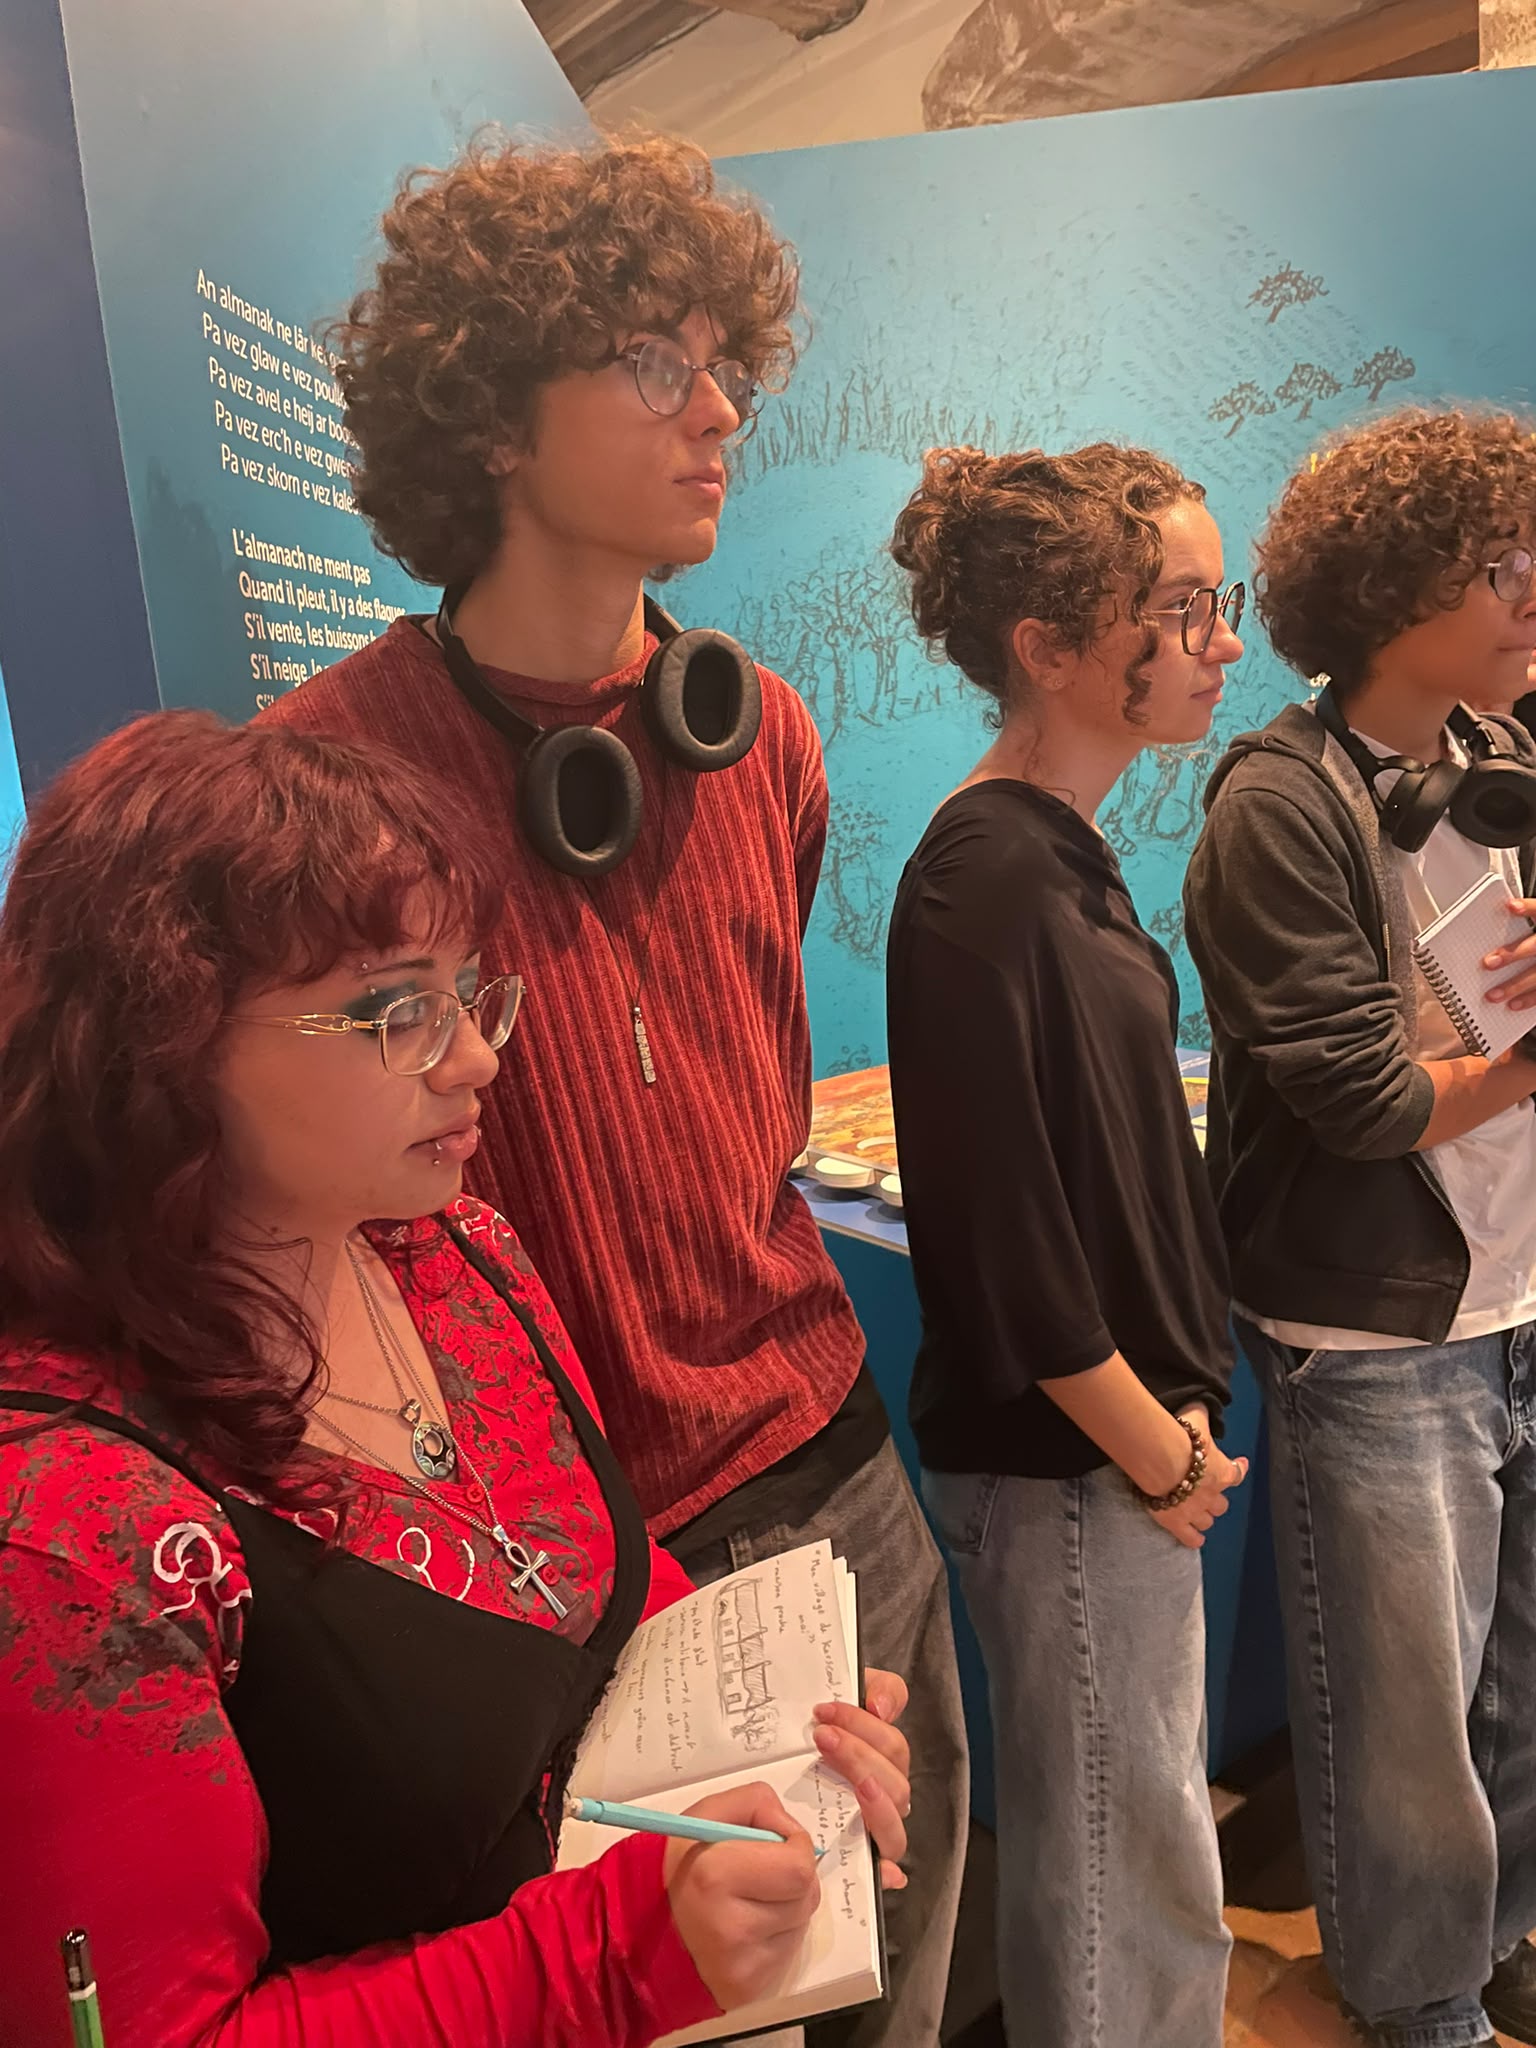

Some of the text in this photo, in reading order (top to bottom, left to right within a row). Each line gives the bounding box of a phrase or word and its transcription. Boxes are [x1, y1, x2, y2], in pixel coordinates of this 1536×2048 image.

[197, 269, 217, 303] An
[220, 286, 274, 336] almanak
[277, 321, 292, 344] ne
[203, 312, 220, 345] Pa
[224, 329, 248, 360] vez
[250, 342, 279, 371] glaw
[282, 363, 291, 382] e
[292, 365, 312, 392] vez
[209, 356, 226, 389] Pa
[229, 373, 252, 401] vez
[256, 385, 281, 414] avel
[283, 400, 291, 418] e
[316, 413, 326, 434] ar
[215, 400, 232, 432] Pa
[236, 415, 259, 442] vez
[261, 427, 292, 456] erc'h
[294, 441, 302, 459] e
[304, 442, 323, 468] vez
[221, 443, 239, 475] Pa
[241, 457, 265, 483] vez
[267, 466, 300, 495] skorn
[303, 479, 310, 499] e
[312, 482, 331, 506] vez
[232, 528, 371, 587] L'almanach ne ment pas
[239, 571, 285, 604] Quand
[286, 580, 295, 606] il
[297, 583, 330, 614] pleut,
[330, 589, 339, 612] il
[339, 595, 346, 620] y
[348, 598, 354, 616] a
[356, 596, 373, 618] des
[244, 612, 266, 640] S'il
[267, 620, 306, 648] vente,
[307, 622, 323, 645] les
[250, 653, 272, 680] S'il
[819, 1623, 831, 1634] de
